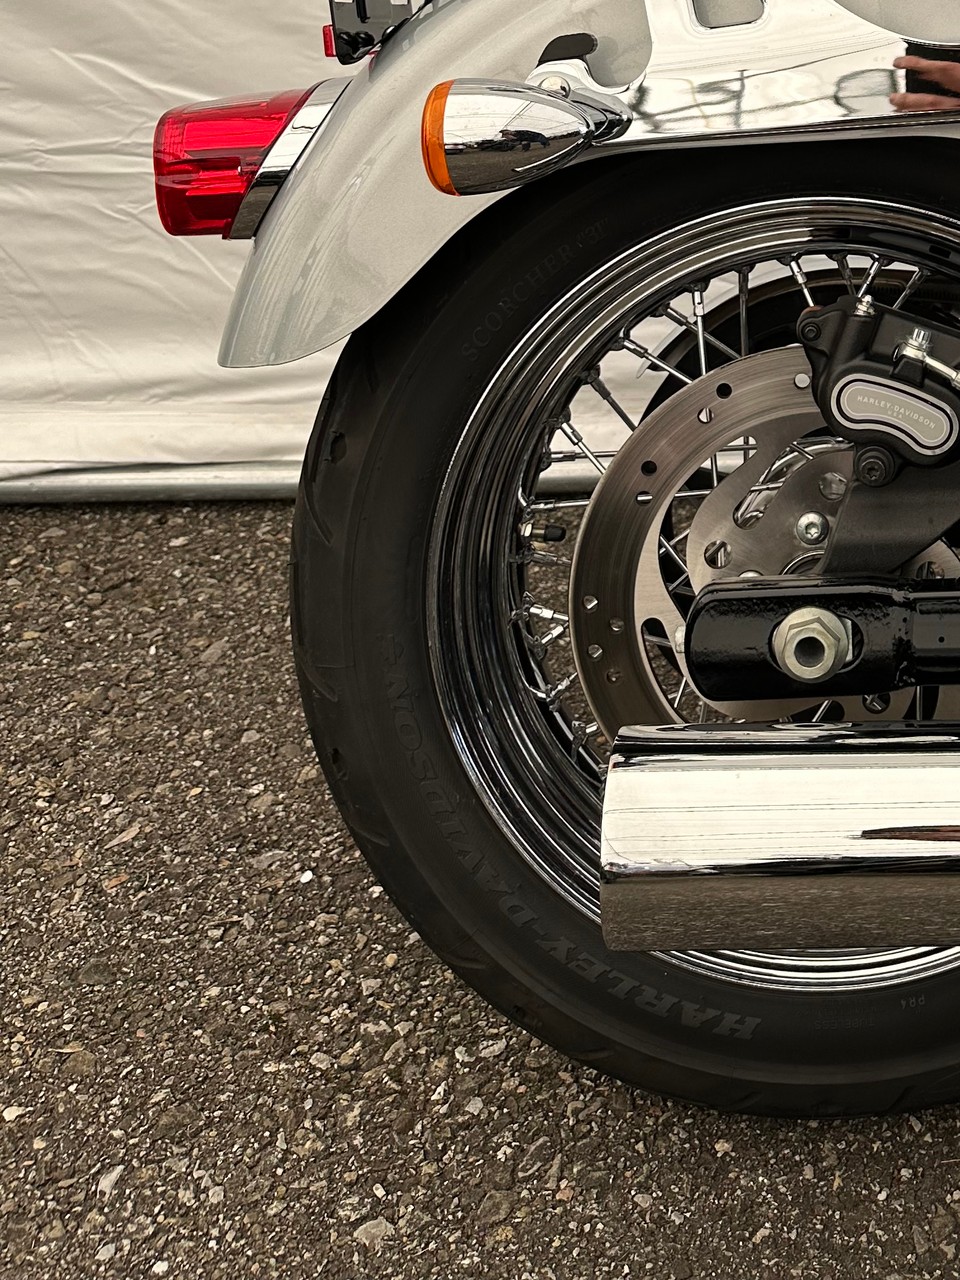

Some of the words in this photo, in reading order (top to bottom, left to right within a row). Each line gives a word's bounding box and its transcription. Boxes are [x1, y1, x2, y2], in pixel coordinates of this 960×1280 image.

[461, 243, 577, 362] SCORCHER
[857, 395, 936, 429] HARLEY-DAVIDSON
[384, 671, 762, 1041] HARLEY-DAVIDSON
